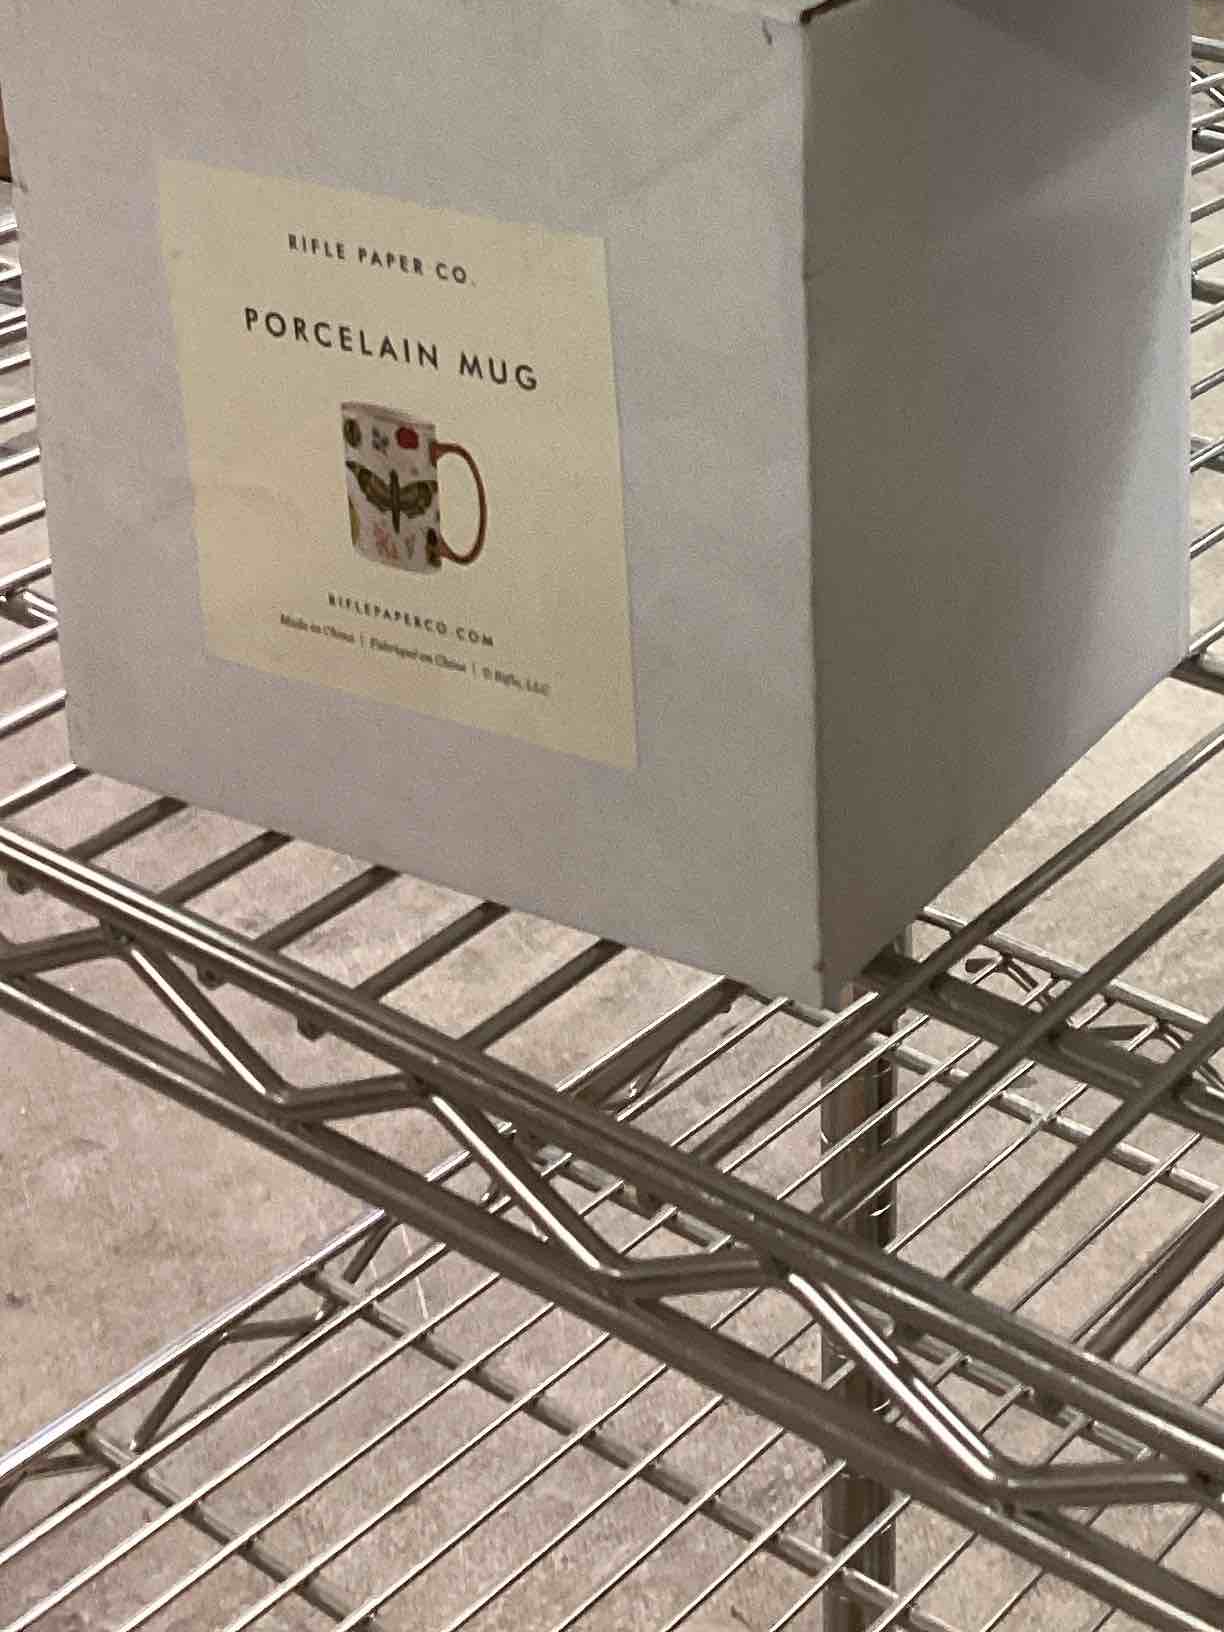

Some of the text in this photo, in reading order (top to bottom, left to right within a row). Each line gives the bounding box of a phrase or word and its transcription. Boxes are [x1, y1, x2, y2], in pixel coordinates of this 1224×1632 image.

[288, 233, 477, 287] RIFLE PAPER CO.
[244, 306, 538, 392] PORCELAIN MUG
